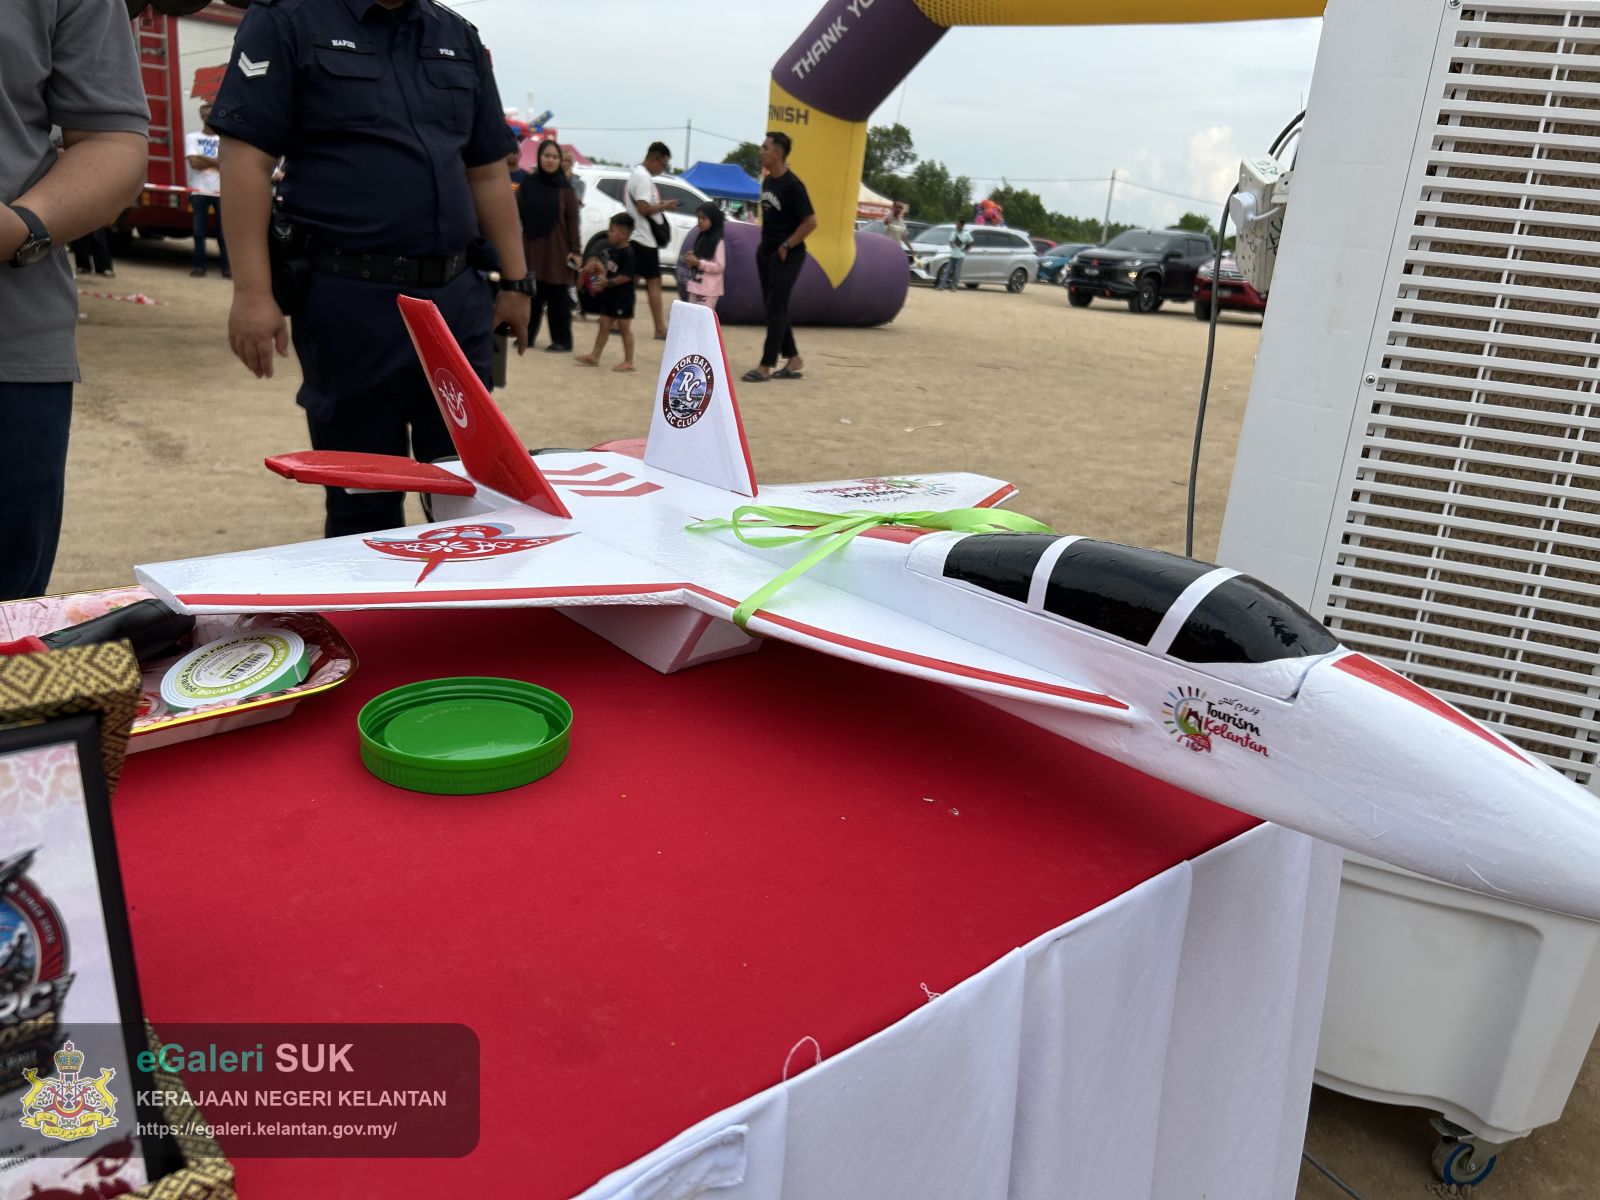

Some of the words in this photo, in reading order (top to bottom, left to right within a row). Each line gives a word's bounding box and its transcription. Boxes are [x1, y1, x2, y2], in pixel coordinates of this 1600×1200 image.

[791, 15, 849, 80] THANK
[847, 0, 876, 19] YO
[675, 356, 692, 372] TOK
[693, 355, 711, 374] BALI
[679, 371, 700, 402] RC
[666, 411, 676, 425] RC
[676, 414, 698, 428] CLUB
[210, 640, 239, 653] FOAM
[184, 653, 208, 673] SIDED
[181, 673, 198, 693] DOUBLE
[1206, 701, 1261, 737] Tourism
[1203, 719, 1270, 757] Kelantan
